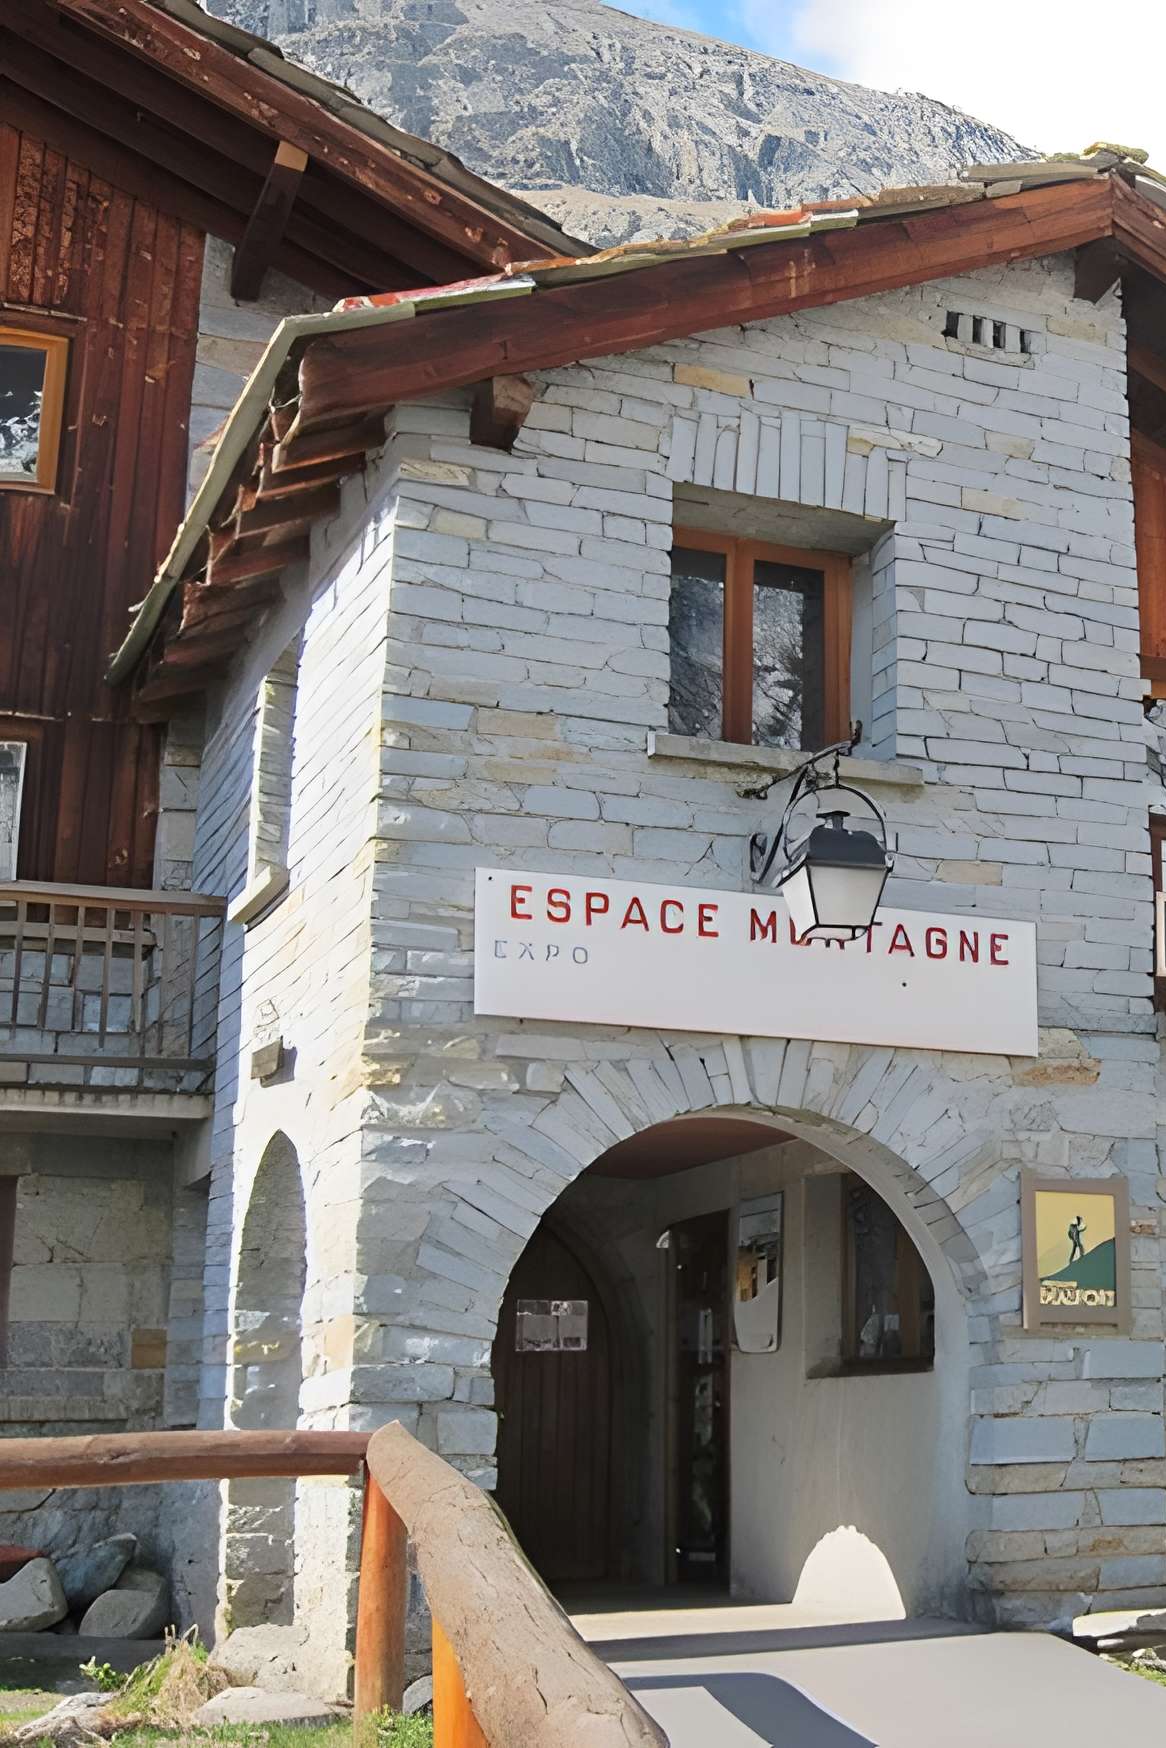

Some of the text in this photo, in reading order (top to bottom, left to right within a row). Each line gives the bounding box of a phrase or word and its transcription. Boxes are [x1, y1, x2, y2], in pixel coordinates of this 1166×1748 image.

[494, 939, 588, 964] EXPO
[510, 884, 1009, 966] ESPACE MTAGNE
